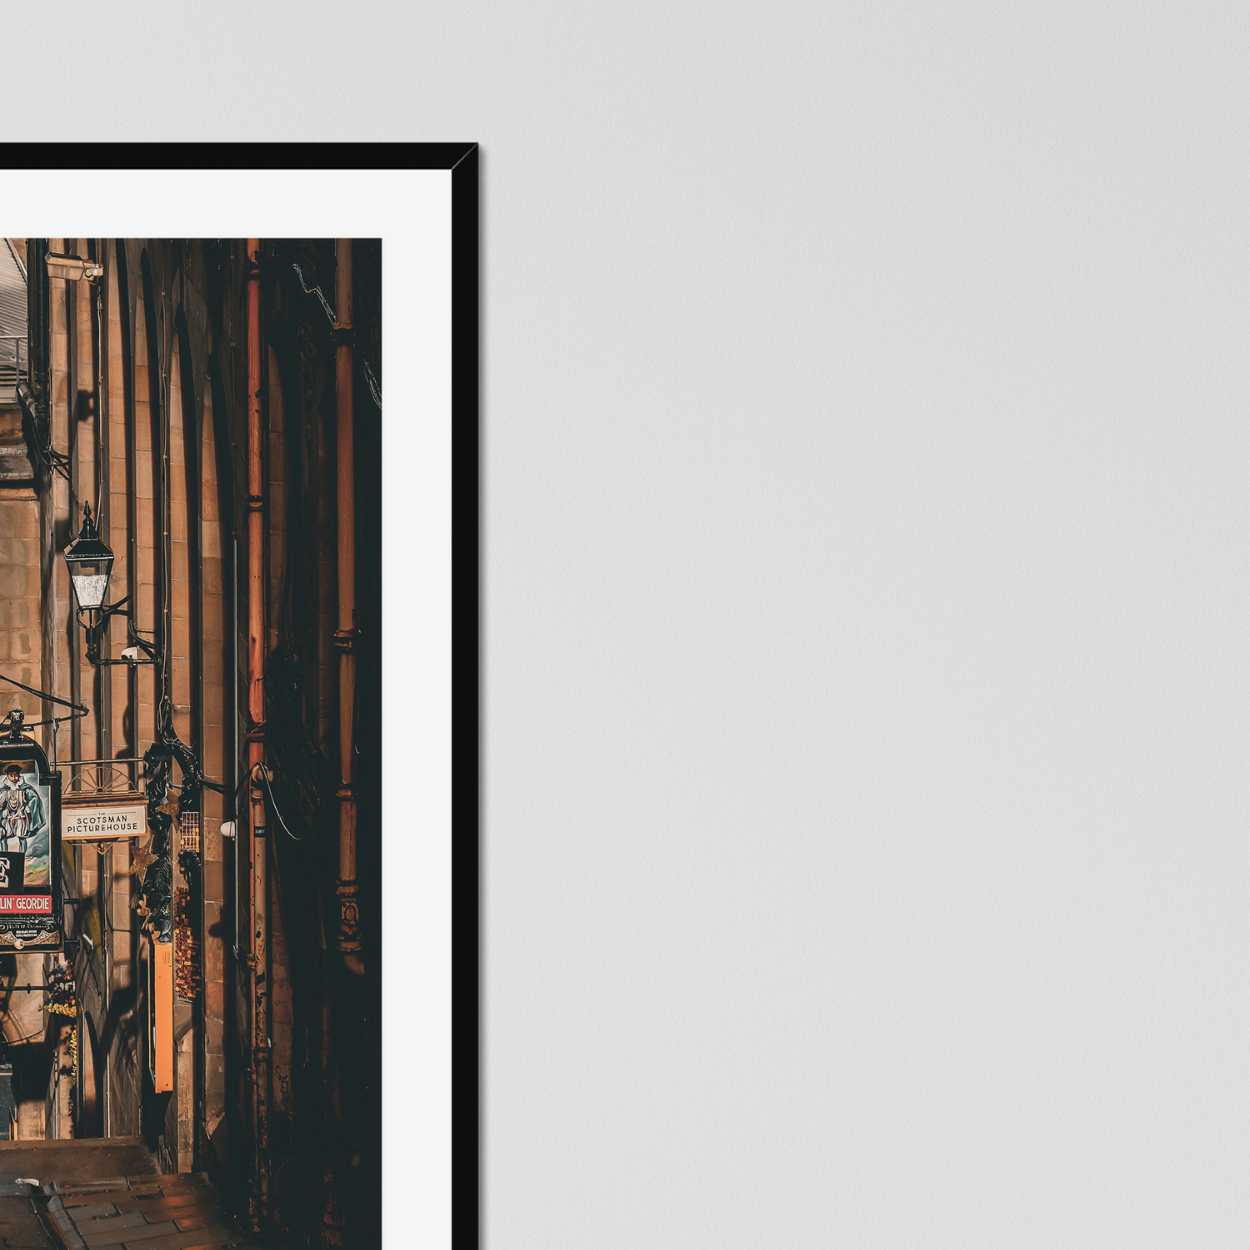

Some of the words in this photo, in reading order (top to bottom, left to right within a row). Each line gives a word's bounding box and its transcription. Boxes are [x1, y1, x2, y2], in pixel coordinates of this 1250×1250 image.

[77, 815, 128, 825] SCOTSMAN
[67, 823, 138, 833] PICTUREHOUSE
[16, 897, 50, 910] GEORDIE
